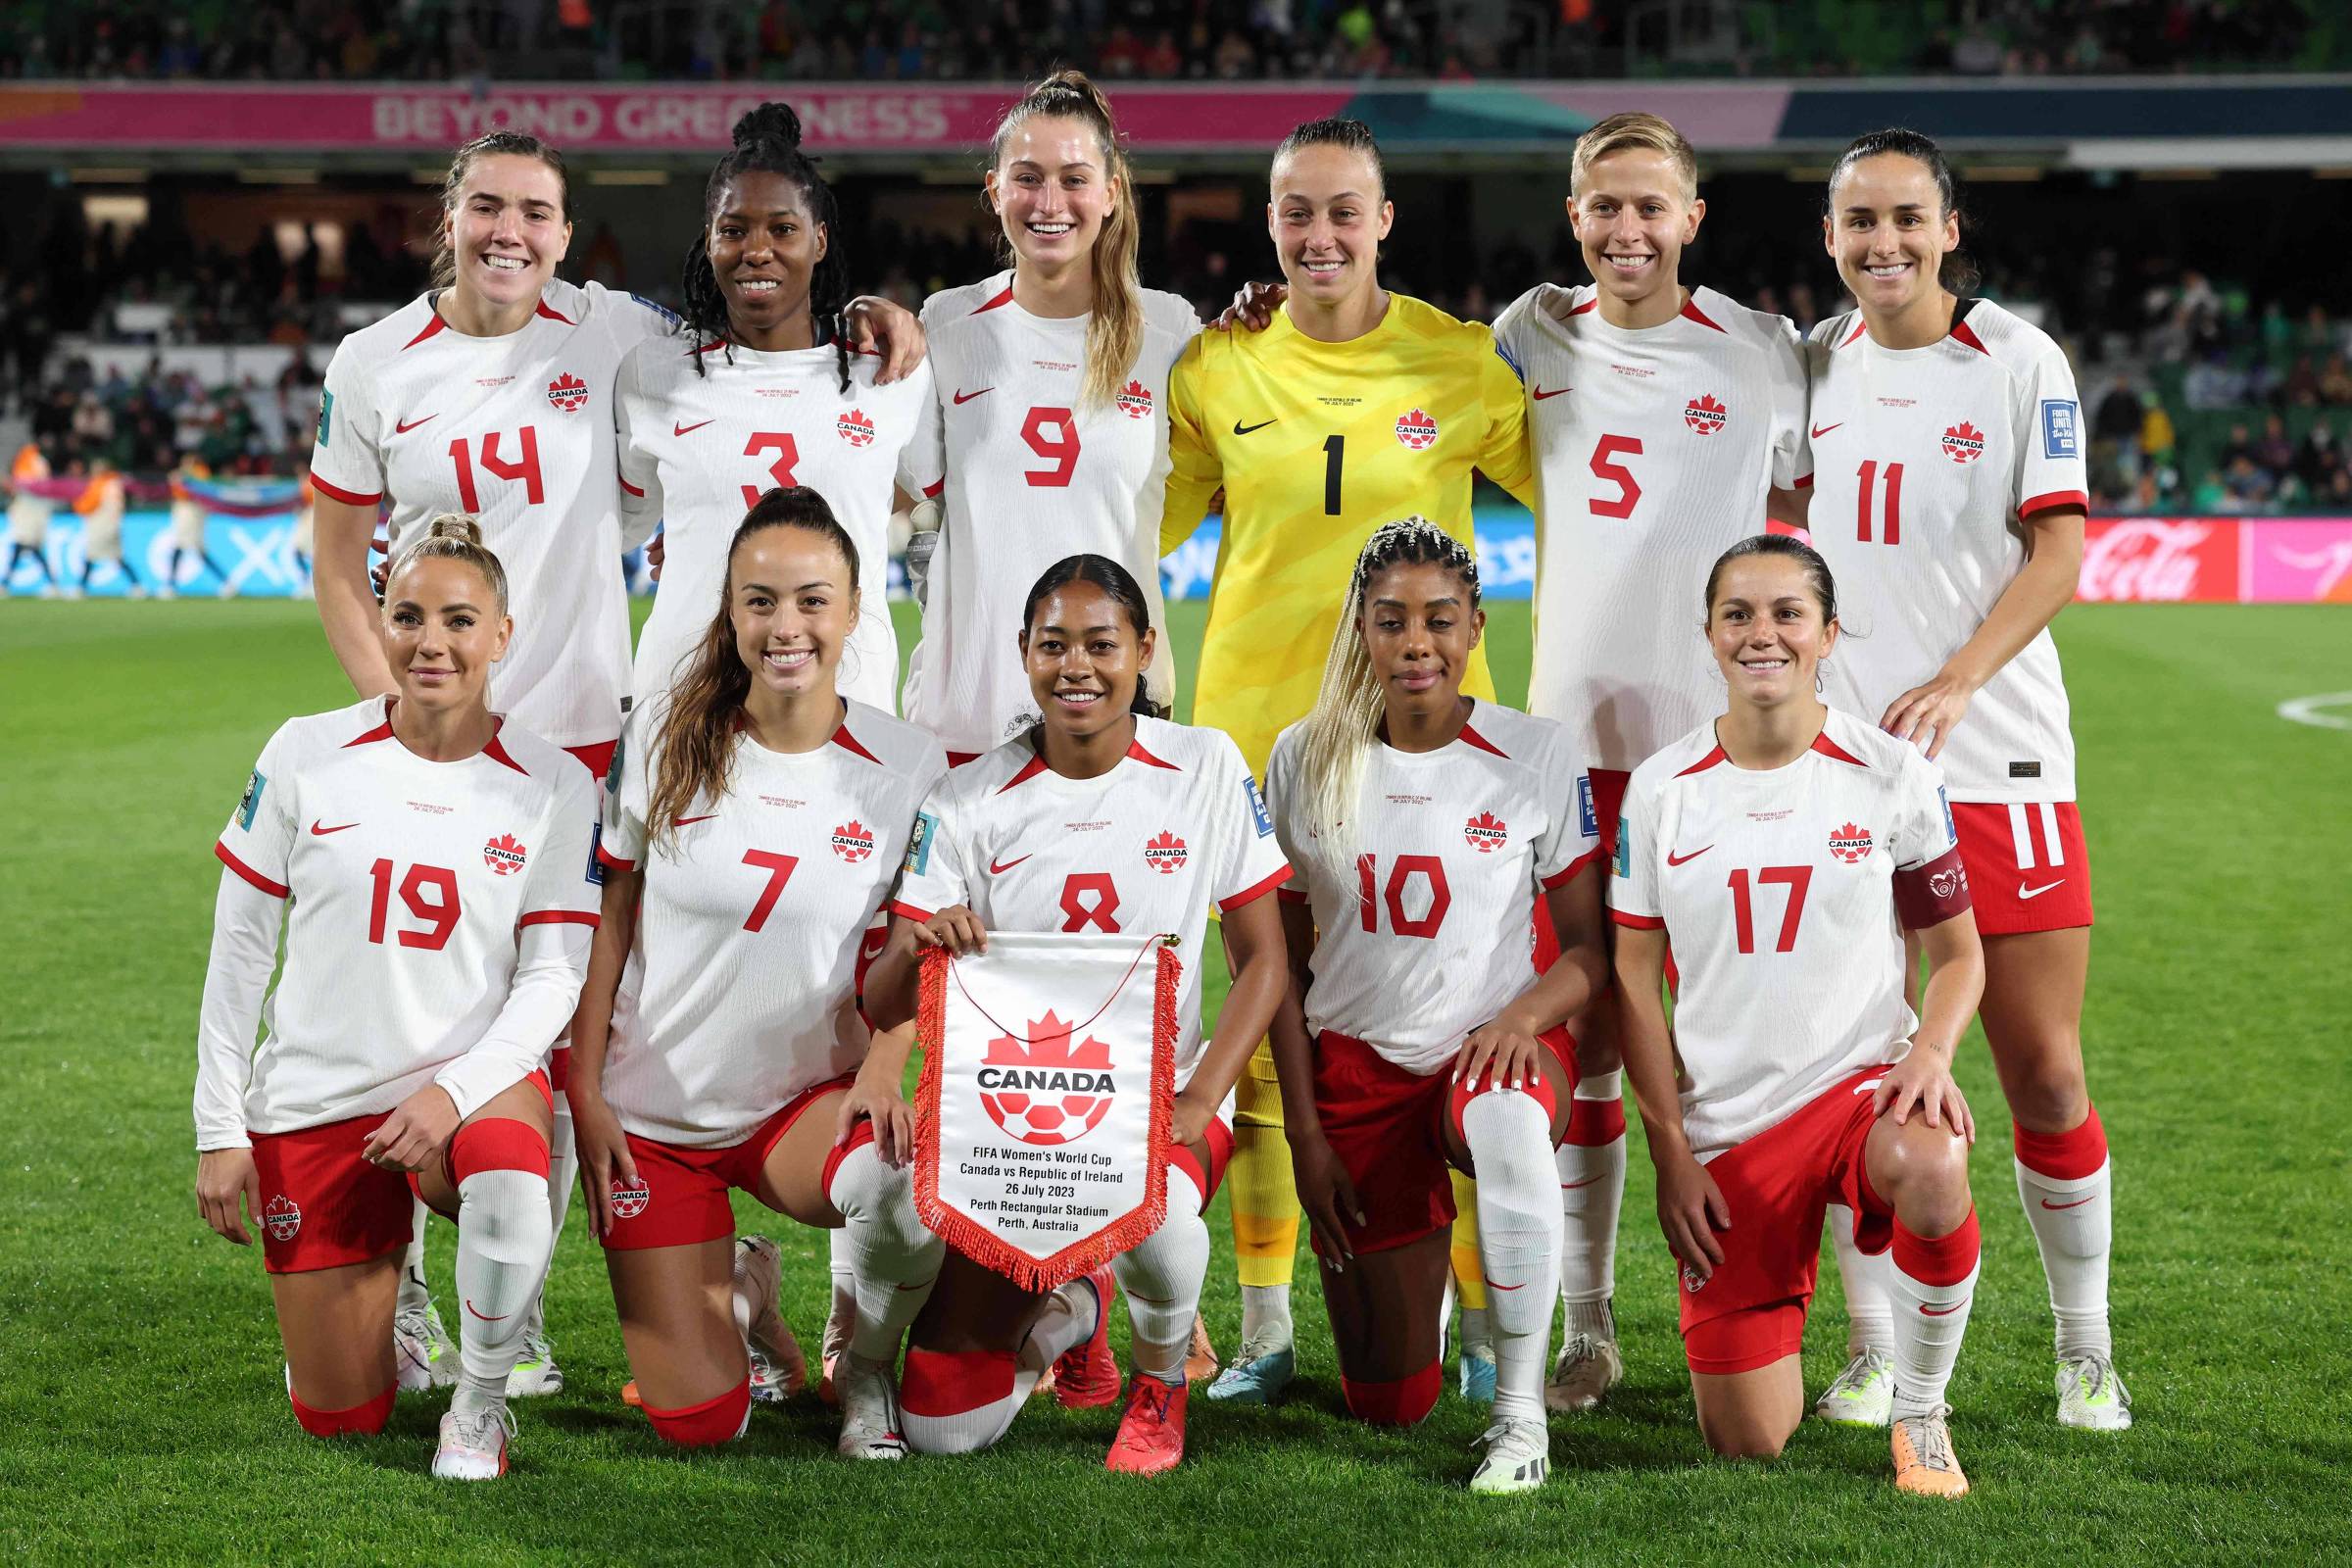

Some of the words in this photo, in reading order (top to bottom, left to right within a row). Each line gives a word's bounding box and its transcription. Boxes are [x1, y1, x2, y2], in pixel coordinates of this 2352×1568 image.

[373, 99, 600, 139] BEYOND
[548, 388, 588, 399] CANADA
[1115, 394, 1152, 407] CANADA
[1685, 409, 1726, 421] CANADA
[837, 422, 875, 436] CANADA
[1396, 426, 1437, 435] CANADA
[1021, 407, 1081, 487] 9
[1941, 436, 1984, 450] CANADA
[449, 426, 544, 514] 14
[741, 432, 800, 511] 3
[1323, 434, 1345, 516] 1
[1589, 434, 1643, 519] 5
[1857, 461, 1903, 545] 11
[831, 836, 873, 849] CANADA
[1464, 827, 1507, 839] CANADA
[2008, 803, 2065, 869] 11
[1829, 839, 1873, 848] CANADA
[483, 847, 526, 863] CANADA
[1145, 849, 1188, 858] CANADA
[742, 848, 799, 932] 7
[1356, 854, 1451, 939] 10
[369, 858, 462, 951] 19
[1059, 873, 1121, 933] 8
[1728, 865, 1813, 955] 17
[977, 1068, 1116, 1093] CANADA
[973, 1147, 998, 1159] FIFA
[1001, 1148, 1052, 1162] Women's
[1054, 1152, 1088, 1164] World
[1091, 1153, 1112, 1167] Cup
[960, 1163, 1001, 1177] Canada
[1004, 1167, 1015, 1177] vs
[1019, 1167, 1067, 1181] Republic
[1070, 1170, 1081, 1181] of
[1084, 1170, 1123, 1184] Ireland
[611, 1192, 648, 1200] CANADA
[1005, 1183, 1019, 1195] 26
[1021, 1184, 1045, 1199] July
[1048, 1186, 1075, 1198] 2023
[970, 1199, 998, 1211] Perth
[1001, 1200, 1063, 1216] Rectangular
[1065, 1204, 1108, 1217] Stadium
[268, 1214, 299, 1224] CANADA
[998, 1216, 1029, 1231] Perth,
[1032, 1218, 1079, 1232] Australia
